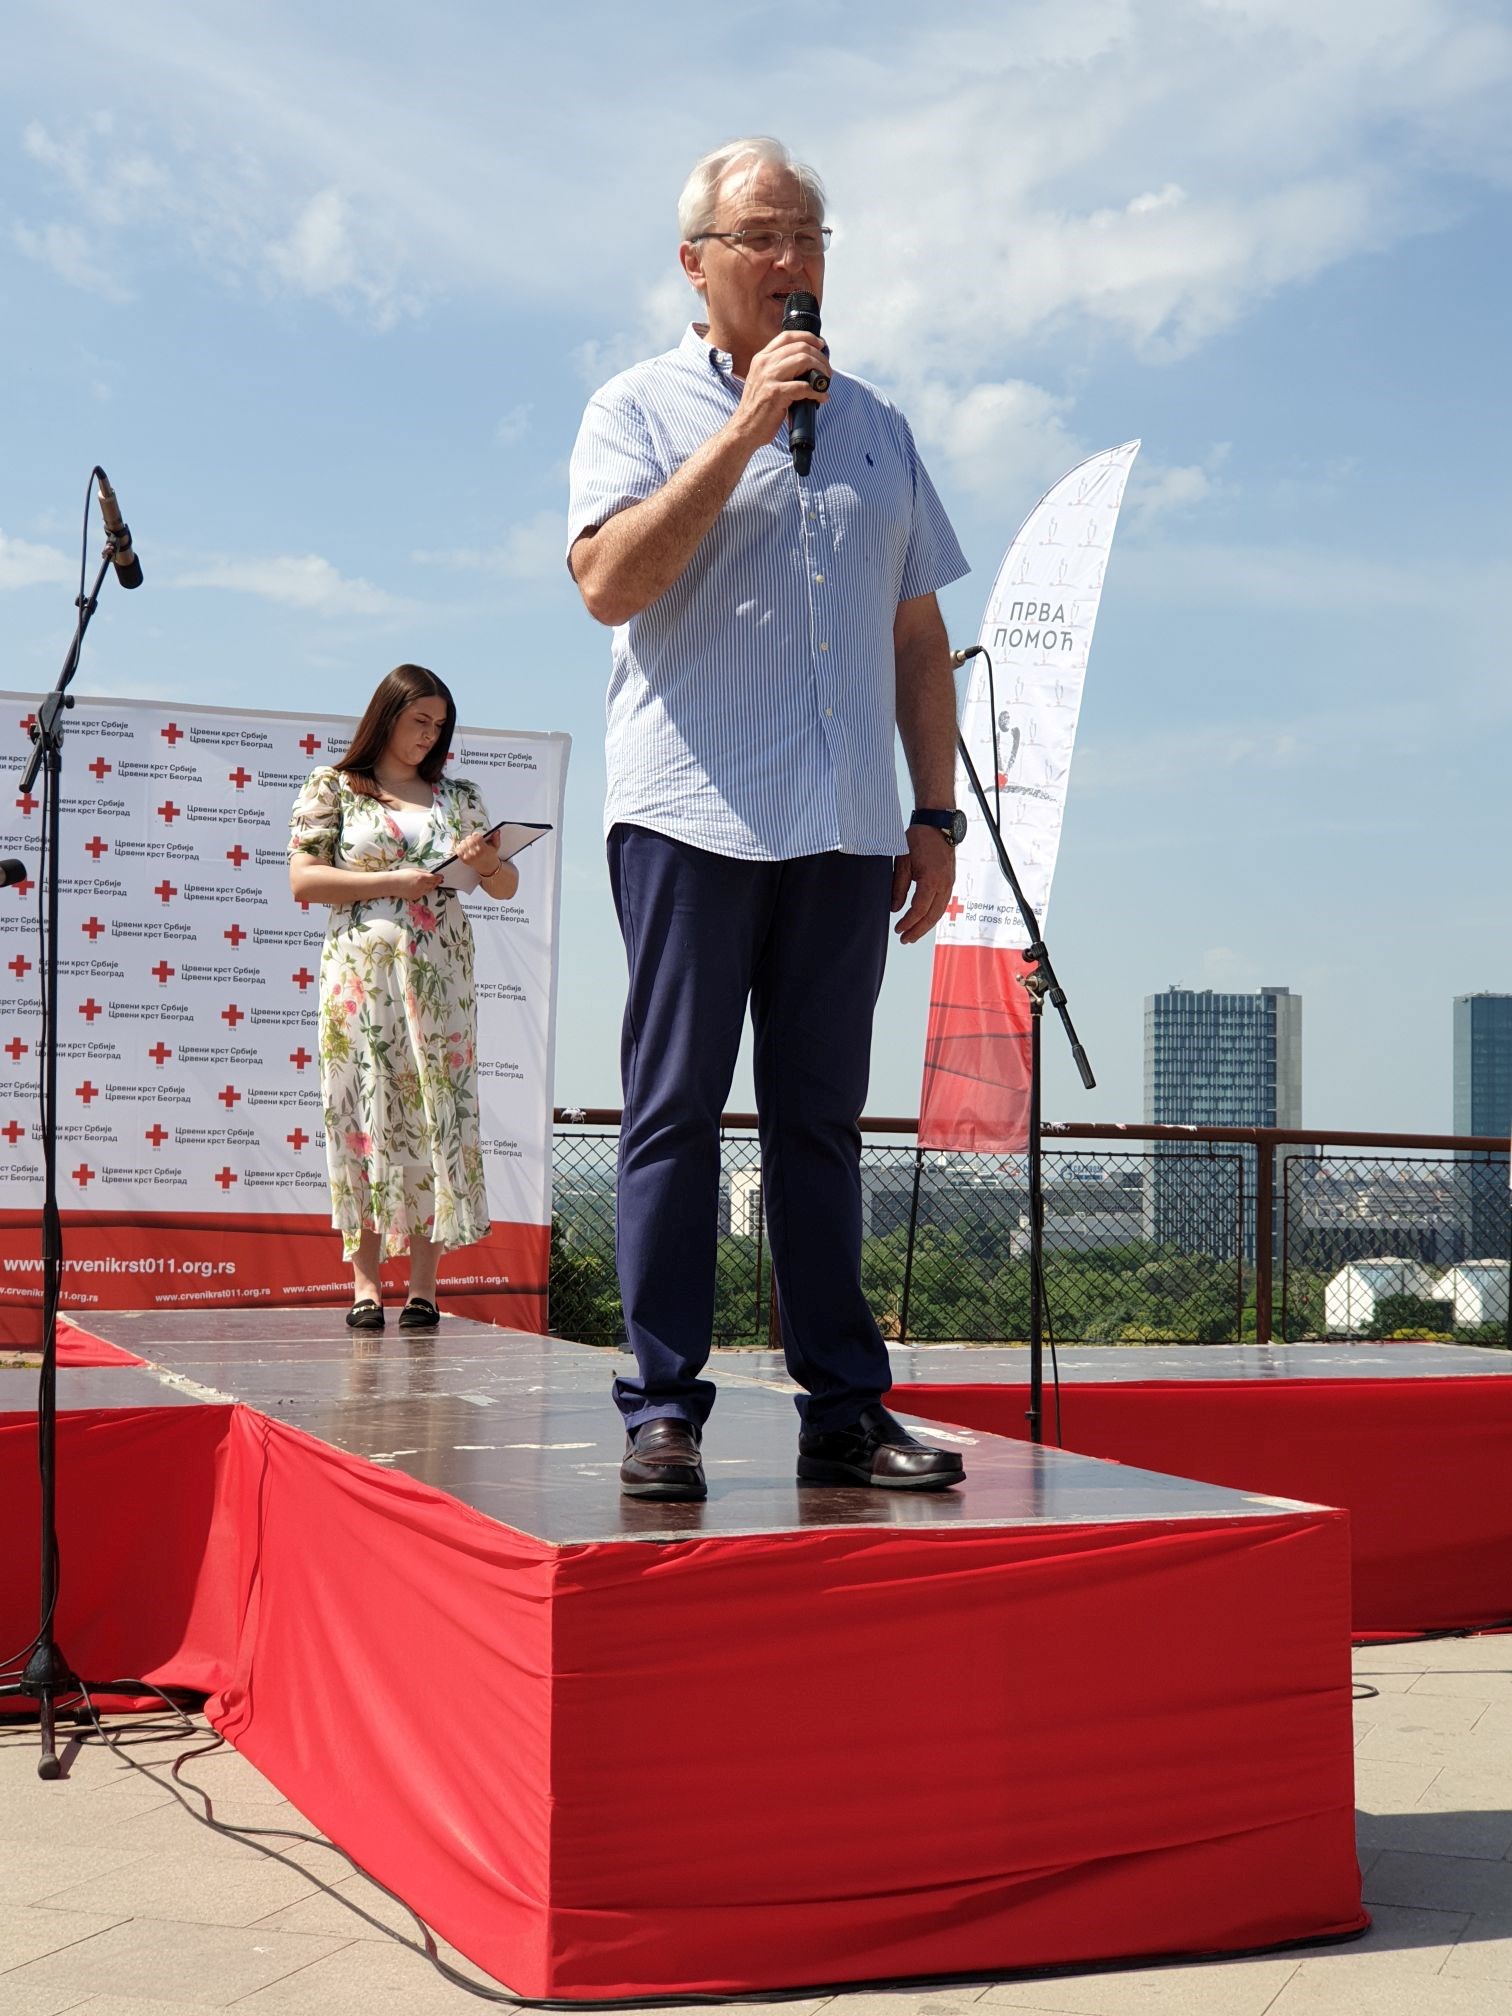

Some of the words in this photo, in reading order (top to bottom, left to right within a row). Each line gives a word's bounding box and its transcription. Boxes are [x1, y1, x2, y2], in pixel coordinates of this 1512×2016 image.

[1010, 602, 1065, 623] ПРВА
[993, 628, 1073, 651] ПОМОЋ
[101, 720, 128, 729] Србије
[100, 728, 133, 738] Београд
[190, 727, 220, 735] Црвени
[240, 730, 267, 740] Србије
[189, 735, 219, 744] Црвени
[240, 739, 272, 748] Београд
[460, 748, 488, 757] Црвени
[507, 752, 532, 761] Србије
[118, 760, 148, 768] Црвени
[169, 764, 196, 773] Србије
[460, 757, 488, 765] Црвени
[507, 760, 537, 769] Београд
[118, 768, 148, 777] Црвени
[169, 772, 202, 782] Београд
[258, 770, 287, 779] Црвени
[257, 779, 287, 787] Црвени
[97, 798, 124, 807] Србије
[97, 807, 130, 816] Београд
[187, 804, 217, 813] Црвени
[238, 808, 264, 817] Србије
[186, 813, 216, 821] Црвени
[237, 816, 270, 825] Београд
[114, 839, 145, 847] Црвени
[166, 842, 193, 851] Србије
[114, 848, 144, 856] Црвени
[166, 851, 199, 860] Београд
[255, 848, 285, 856] Црвени
[255, 857, 284, 865] Црвени
[93, 878, 121, 887] Србије
[93, 887, 127, 896] Београд
[184, 883, 214, 892] Црвени
[235, 886, 262, 895] Србије
[183, 892, 214, 900] Црвени
[235, 895, 267, 904] Београд
[500, 905, 524, 914] Србије
[966, 901, 994, 911] Црвени
[996, 904, 1014, 914] крст
[500, 914, 529, 923] Београд
[965, 913, 977, 921] Red
[978, 914, 1003, 924] cross
[111, 919, 142, 928] Црвени
[163, 922, 191, 931] Србије
[111, 928, 142, 936] Црвени
[163, 931, 196, 940] Београд
[253, 927, 282, 935] Црвени
[252, 936, 282, 944] Црвени
[90, 959, 118, 968] Србије
[90, 968, 124, 977] Београд
[181, 964, 212, 972] Црвени
[233, 966, 260, 975] Србије
[181, 972, 211, 980] Црвени
[232, 975, 265, 984] Београд
[497, 983, 521, 992] Србије
[497, 991, 526, 1000] Београд
[108, 1001, 139, 1009] Црвени
[160, 1003, 188, 1012] Србије
[250, 1007, 280, 1015] Црвени
[108, 1010, 139, 1018] Црвени
[160, 1012, 193, 1021] Београд
[250, 1016, 280, 1024] Црвени
[87, 1042, 115, 1050] Србије
[178, 1045, 209, 1053] Црвени
[230, 1047, 257, 1055] Србије
[87, 1050, 121, 1059] Београд
[178, 1054, 208, 1062] Црвени
[230, 1055, 262, 1064] Београд
[495, 1061, 518, 1070] Србије
[495, 1069, 523, 1078] Београд
[105, 1083, 136, 1092] Црвени
[157, 1085, 185, 1094] Србије
[247, 1088, 277, 1096] Црвени
[105, 1092, 136, 1101] Црвени
[157, 1094, 190, 1102] Београд
[247, 1097, 277, 1105] Црвени
[84, 1124, 112, 1133] Србије
[175, 1126, 205, 1135] Црвени
[227, 1128, 254, 1136] Србије
[84, 1133, 118, 1142] Београд
[174, 1136, 205, 1144] Црвени
[226, 1137, 260, 1145] Београд
[493, 1139, 517, 1148] Србије
[493, 1148, 522, 1157] Београд
[102, 1166, 132, 1174] Црвени
[154, 1167, 181, 1176] Србије
[244, 1169, 274, 1177] Црвени
[295, 1170, 321, 1179] Србије
[101, 1175, 132, 1183] Црвени
[153, 1176, 187, 1184] Београд
[244, 1178, 274, 1186] Црвени
[294, 1179, 327, 1187] Београд
[155, 1288, 271, 1302] www.crvenikrst011.org.rs
